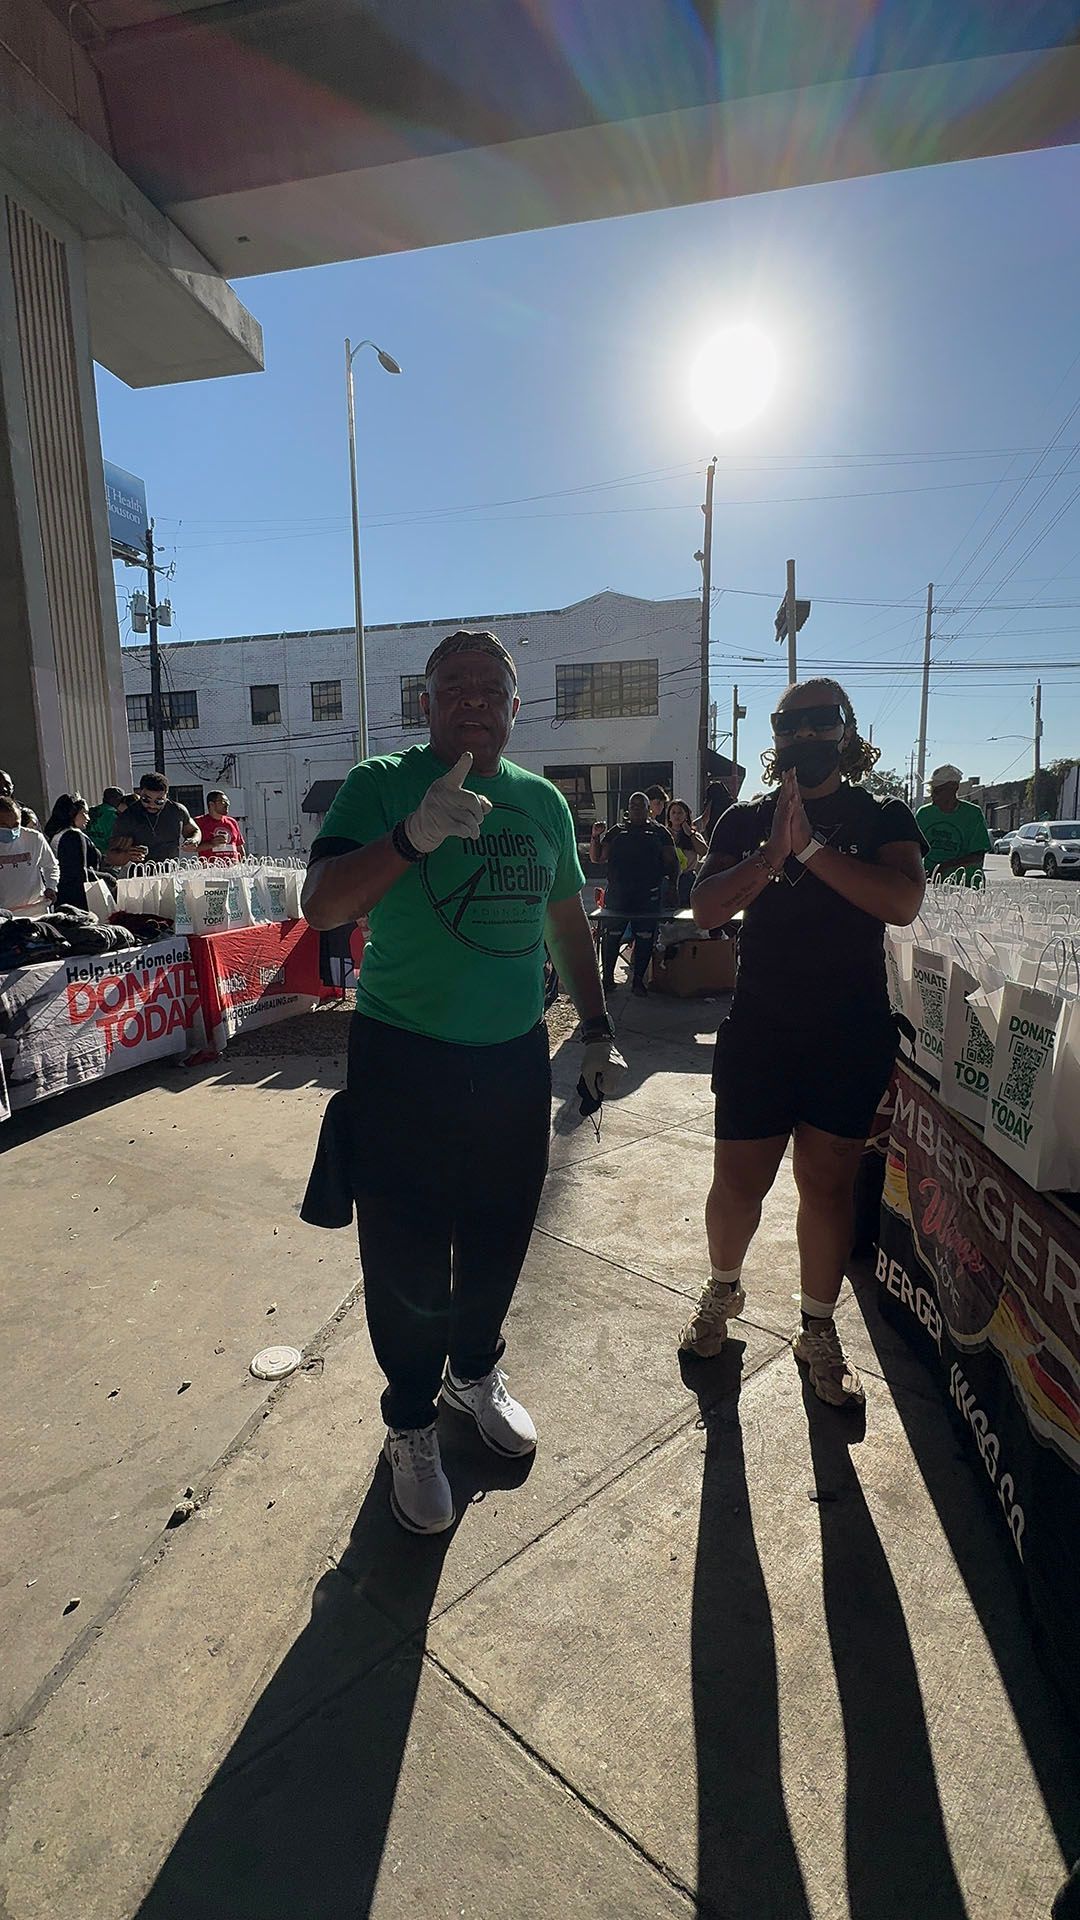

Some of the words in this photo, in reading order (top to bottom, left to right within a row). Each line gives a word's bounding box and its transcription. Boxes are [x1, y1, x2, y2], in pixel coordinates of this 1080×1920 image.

[487, 857, 555, 892] Healin
[203, 916, 225, 926] TODAY
[66, 962, 105, 984] Help
[108, 958, 132, 975] the
[136, 948, 192, 970] Homeles
[912, 967, 948, 991] DONATE
[67, 962, 200, 1026] DONATE
[95, 994, 203, 1057] TODAY
[918, 1028, 944, 1058] TODA
[1008, 1015, 1057, 1050] DONATE
[953, 1061, 990, 1092] TOD
[991, 1098, 1034, 1145] TODAY
